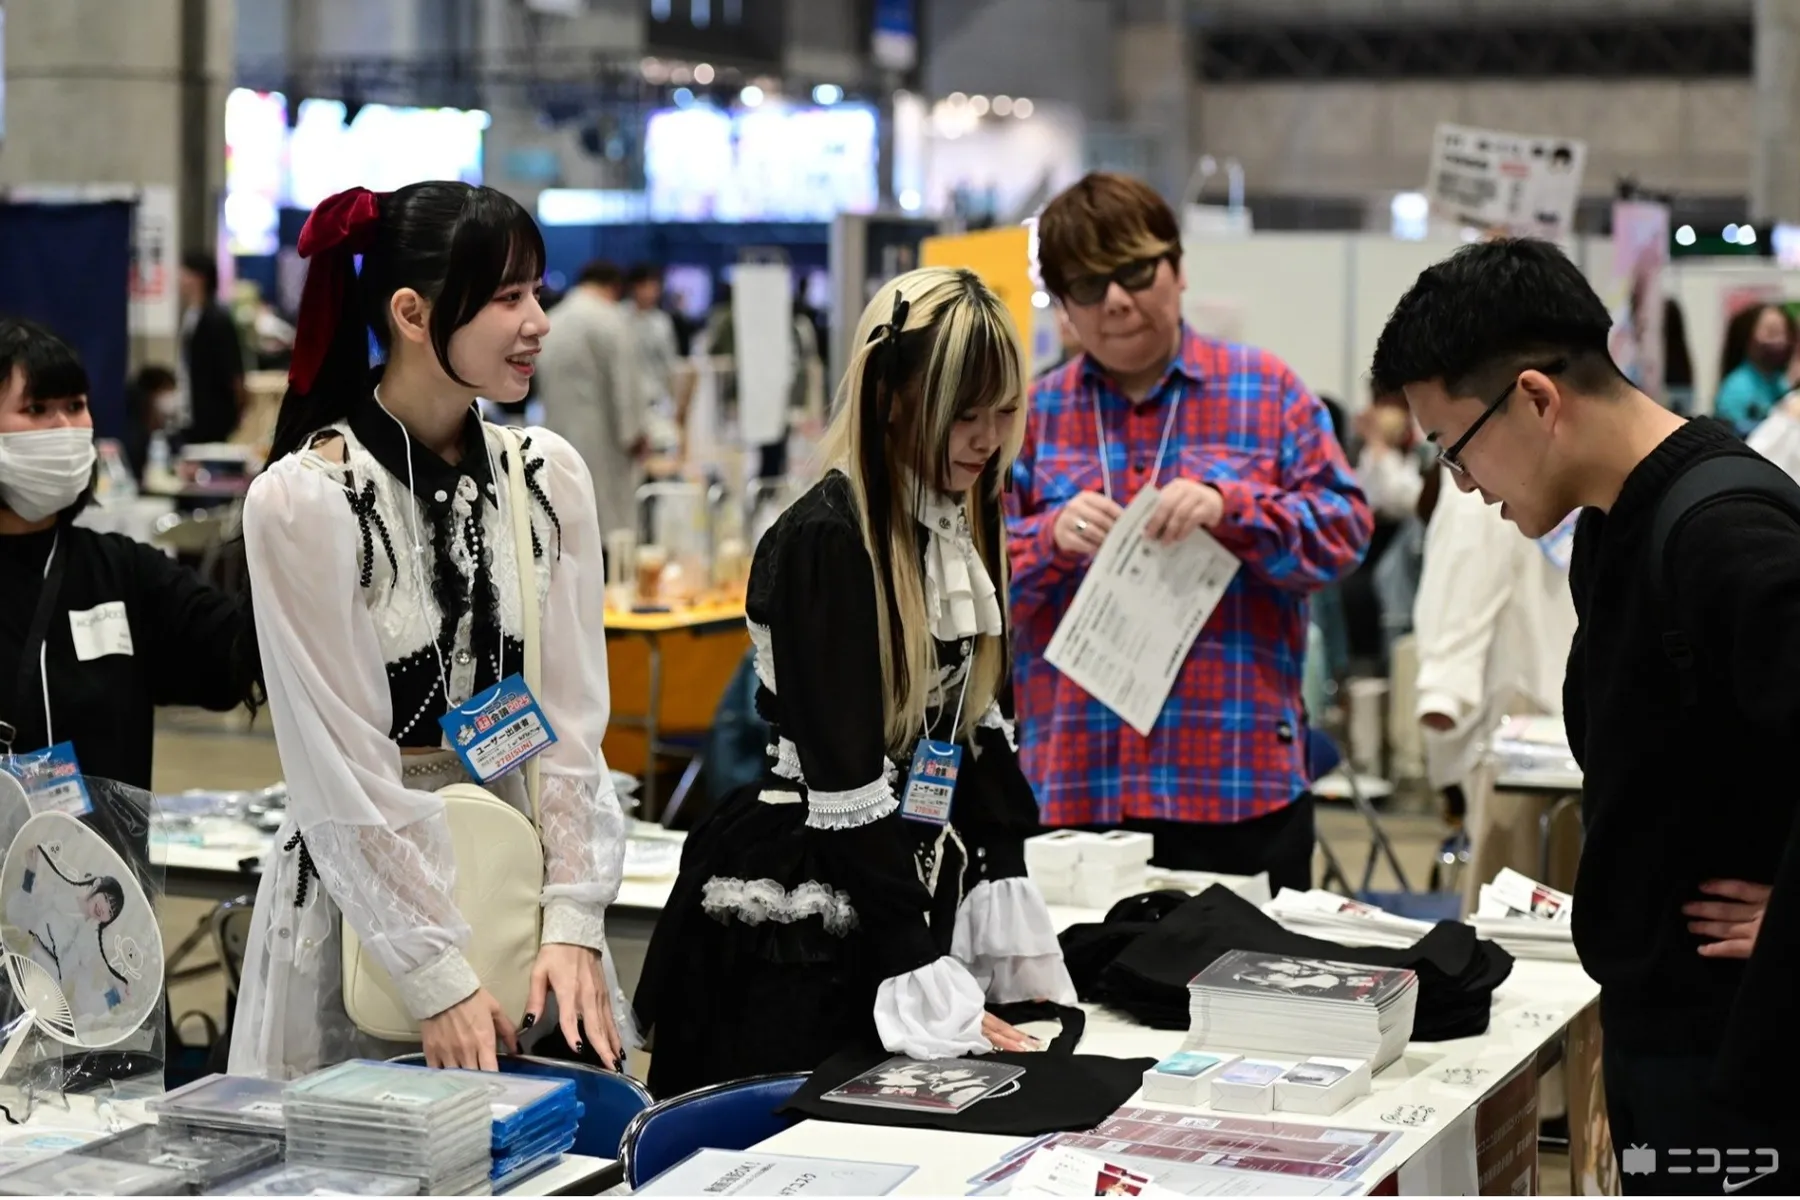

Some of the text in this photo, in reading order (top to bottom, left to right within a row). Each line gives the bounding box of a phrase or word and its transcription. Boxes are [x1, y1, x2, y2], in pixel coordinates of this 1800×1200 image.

[475, 717, 530, 755] ユーザー出展者
